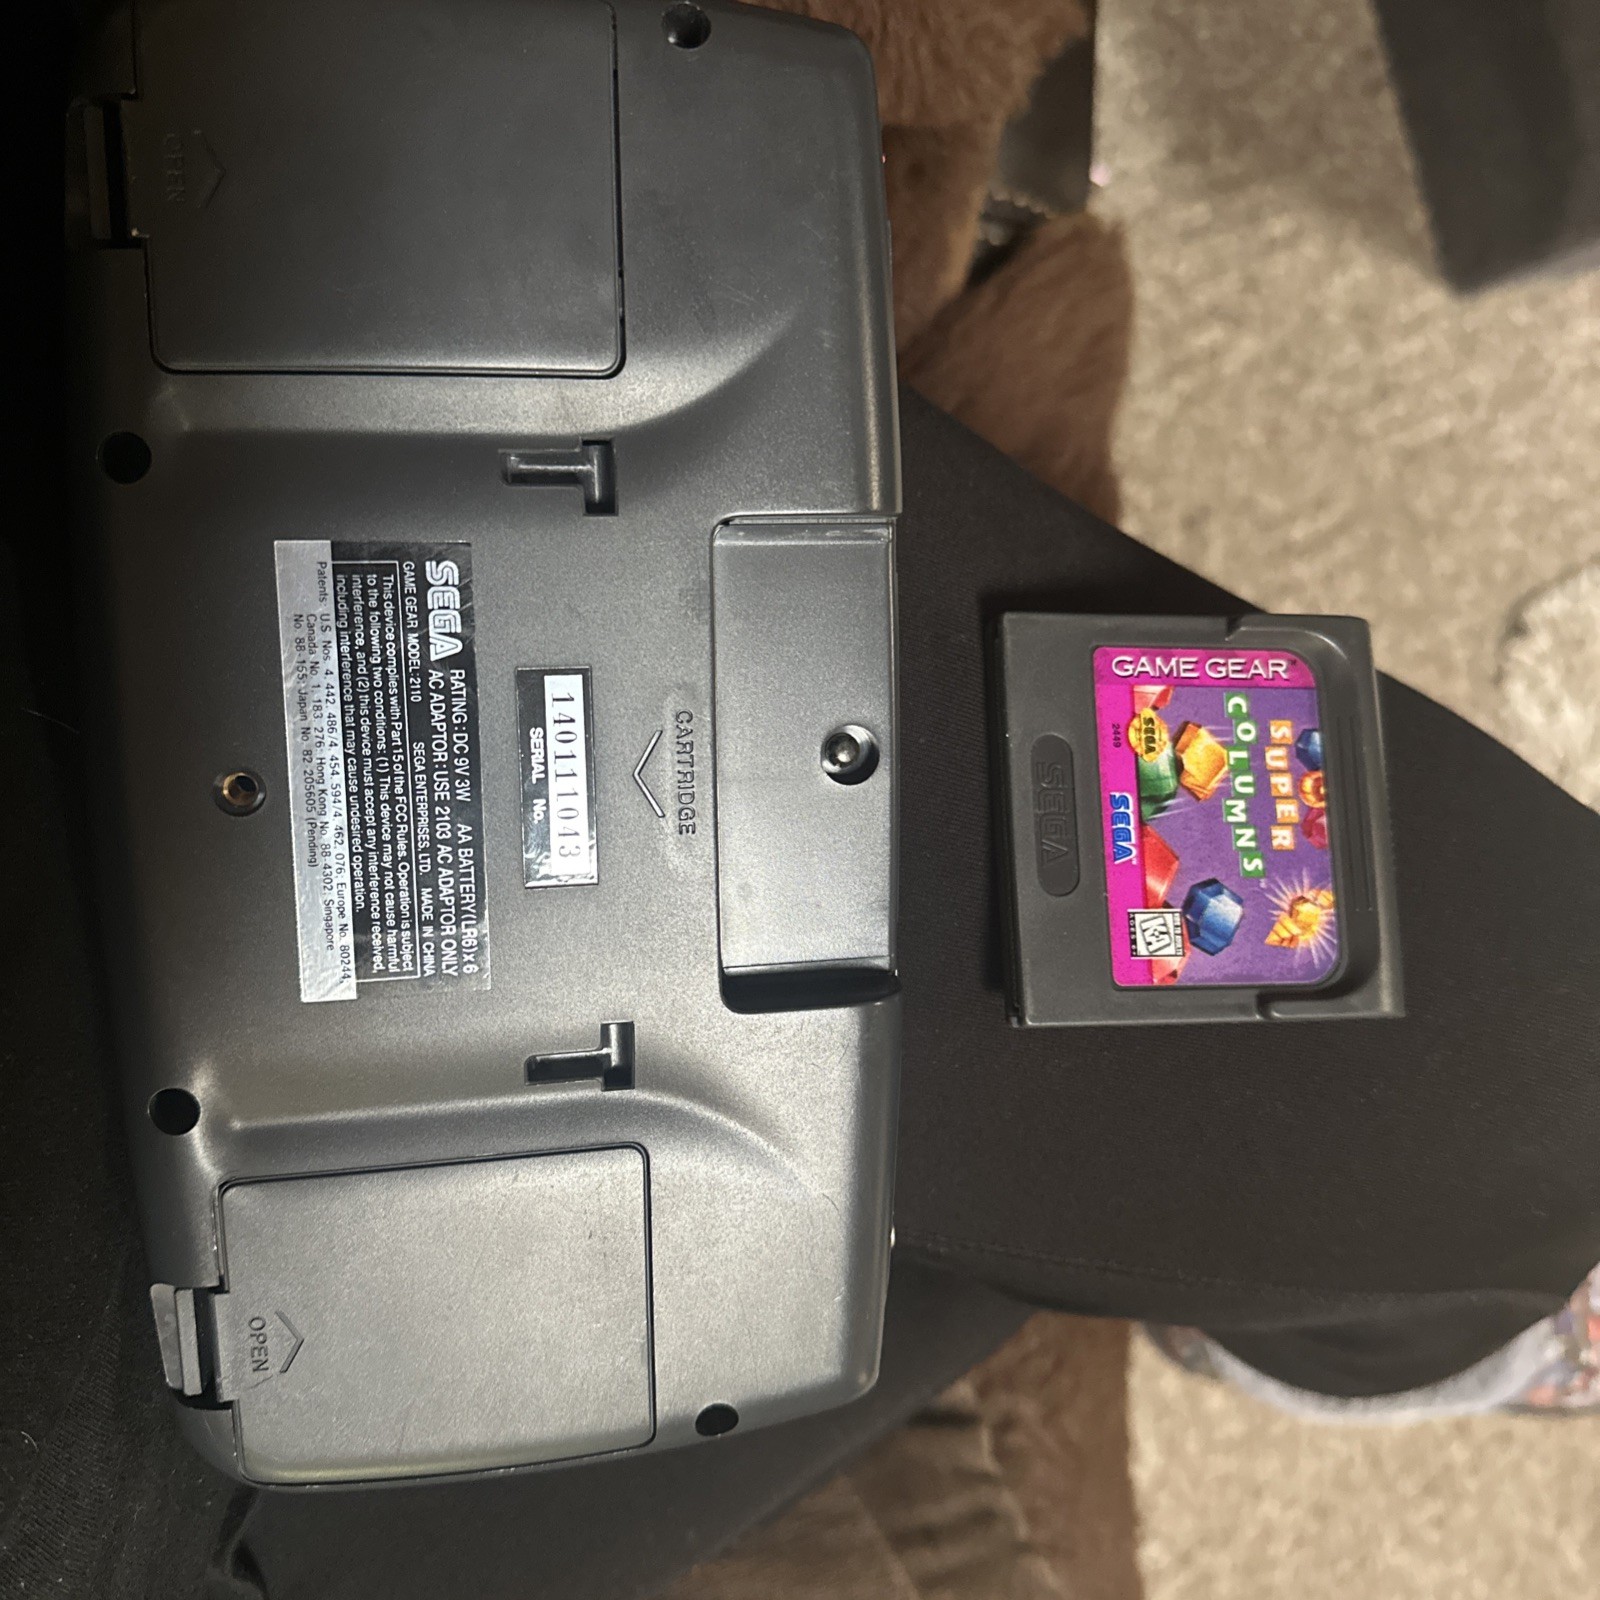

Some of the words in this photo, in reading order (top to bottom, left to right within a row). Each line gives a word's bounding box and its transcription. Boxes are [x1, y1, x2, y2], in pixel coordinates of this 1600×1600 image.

[366, 574, 378, 586] to
[381, 574, 395, 600] This
[402, 561, 416, 594] GAME
[333, 574, 350, 628] including
[350, 574, 367, 649] interference,
[367, 588, 379, 607] the
[404, 595, 418, 628] GEAR
[424, 560, 463, 661] SEGA
[305, 613, 319, 655] Canada
[366, 610, 383, 664] following
[382, 601, 397, 640] device
[338, 630, 355, 701] interference
[355, 651, 368, 674] and
[372, 666, 384, 687] two
[383, 641, 400, 694] complies
[427, 669, 444, 689] AC
[1111, 655, 1200, 679] GAME
[354, 676, 370, 692] (2)
[343, 704, 356, 727] that
[358, 694, 371, 715] this
[388, 696, 401, 720] with
[359, 717, 373, 756] device
[373, 690, 388, 754] conditions:
[390, 721, 403, 746] Part
[1112, 724, 1121, 748] 2449
[1143, 716, 1156, 754] SEGA
[316, 561, 330, 606] Patents:
[333, 882, 348, 919] Europe
[342, 729, 356, 755] may
[391, 747, 404, 762] 15
[412, 741, 425, 772] SEGA
[452, 732, 469, 754] DC
[529, 726, 545, 785] SERIAL
[295, 688, 309, 721] Japan
[304, 816, 319, 868] (Pending)
[312, 756, 327, 784] Hong
[347, 756, 359, 792] cause
[362, 757, 374, 786] must
[374, 756, 389, 773] (1)
[392, 762, 405, 774] of
[453, 757, 470, 776] 9V
[551, 692, 581, 858] 140111043
[675, 710, 697, 836] CARTRIDGE
[378, 775, 391, 800] This
[393, 775, 406, 794] the
[432, 770, 450, 801] USE
[454, 778, 471, 802] 3W
[1226, 695, 1264, 872] COLUMNS
[1265, 721, 1298, 849] SUPER
[314, 788, 329, 816] Kong
[362, 787, 377, 826] accept
[394, 795, 408, 822] FCC
[532, 798, 547, 824] No.
[1035, 761, 1068, 868] SEGA
[349, 795, 364, 852] undesired
[379, 802, 393, 841] device
[434, 805, 451, 840] 2103
[456, 822, 473, 844] AA
[1110, 793, 1133, 864] SEGA
[363, 828, 377, 849] any
[395, 824, 409, 860] Rules.
[436, 843, 453, 864] AC
[379, 843, 393, 869] may
[417, 852, 431, 875] LTD.
[350, 854, 367, 912] operation.
[367, 851, 382, 919] interference
[383, 870, 395, 890] not
[395, 861, 412, 918] Operation
[384, 891, 395, 927] cause
[420, 887, 433, 921] MADE
[437, 866, 456, 936] ADAPTOR
[321, 898, 337, 951] Singapore
[400, 919, 412, 929] is
[421, 925, 434, 937] IN
[369, 920, 385, 973] received,
[386, 928, 400, 973] harmful
[398, 929, 414, 972] subject
[421, 940, 436, 977] CHINA
[440, 938, 458, 977] ONLY
[248, 1316, 270, 1373] OPEN
